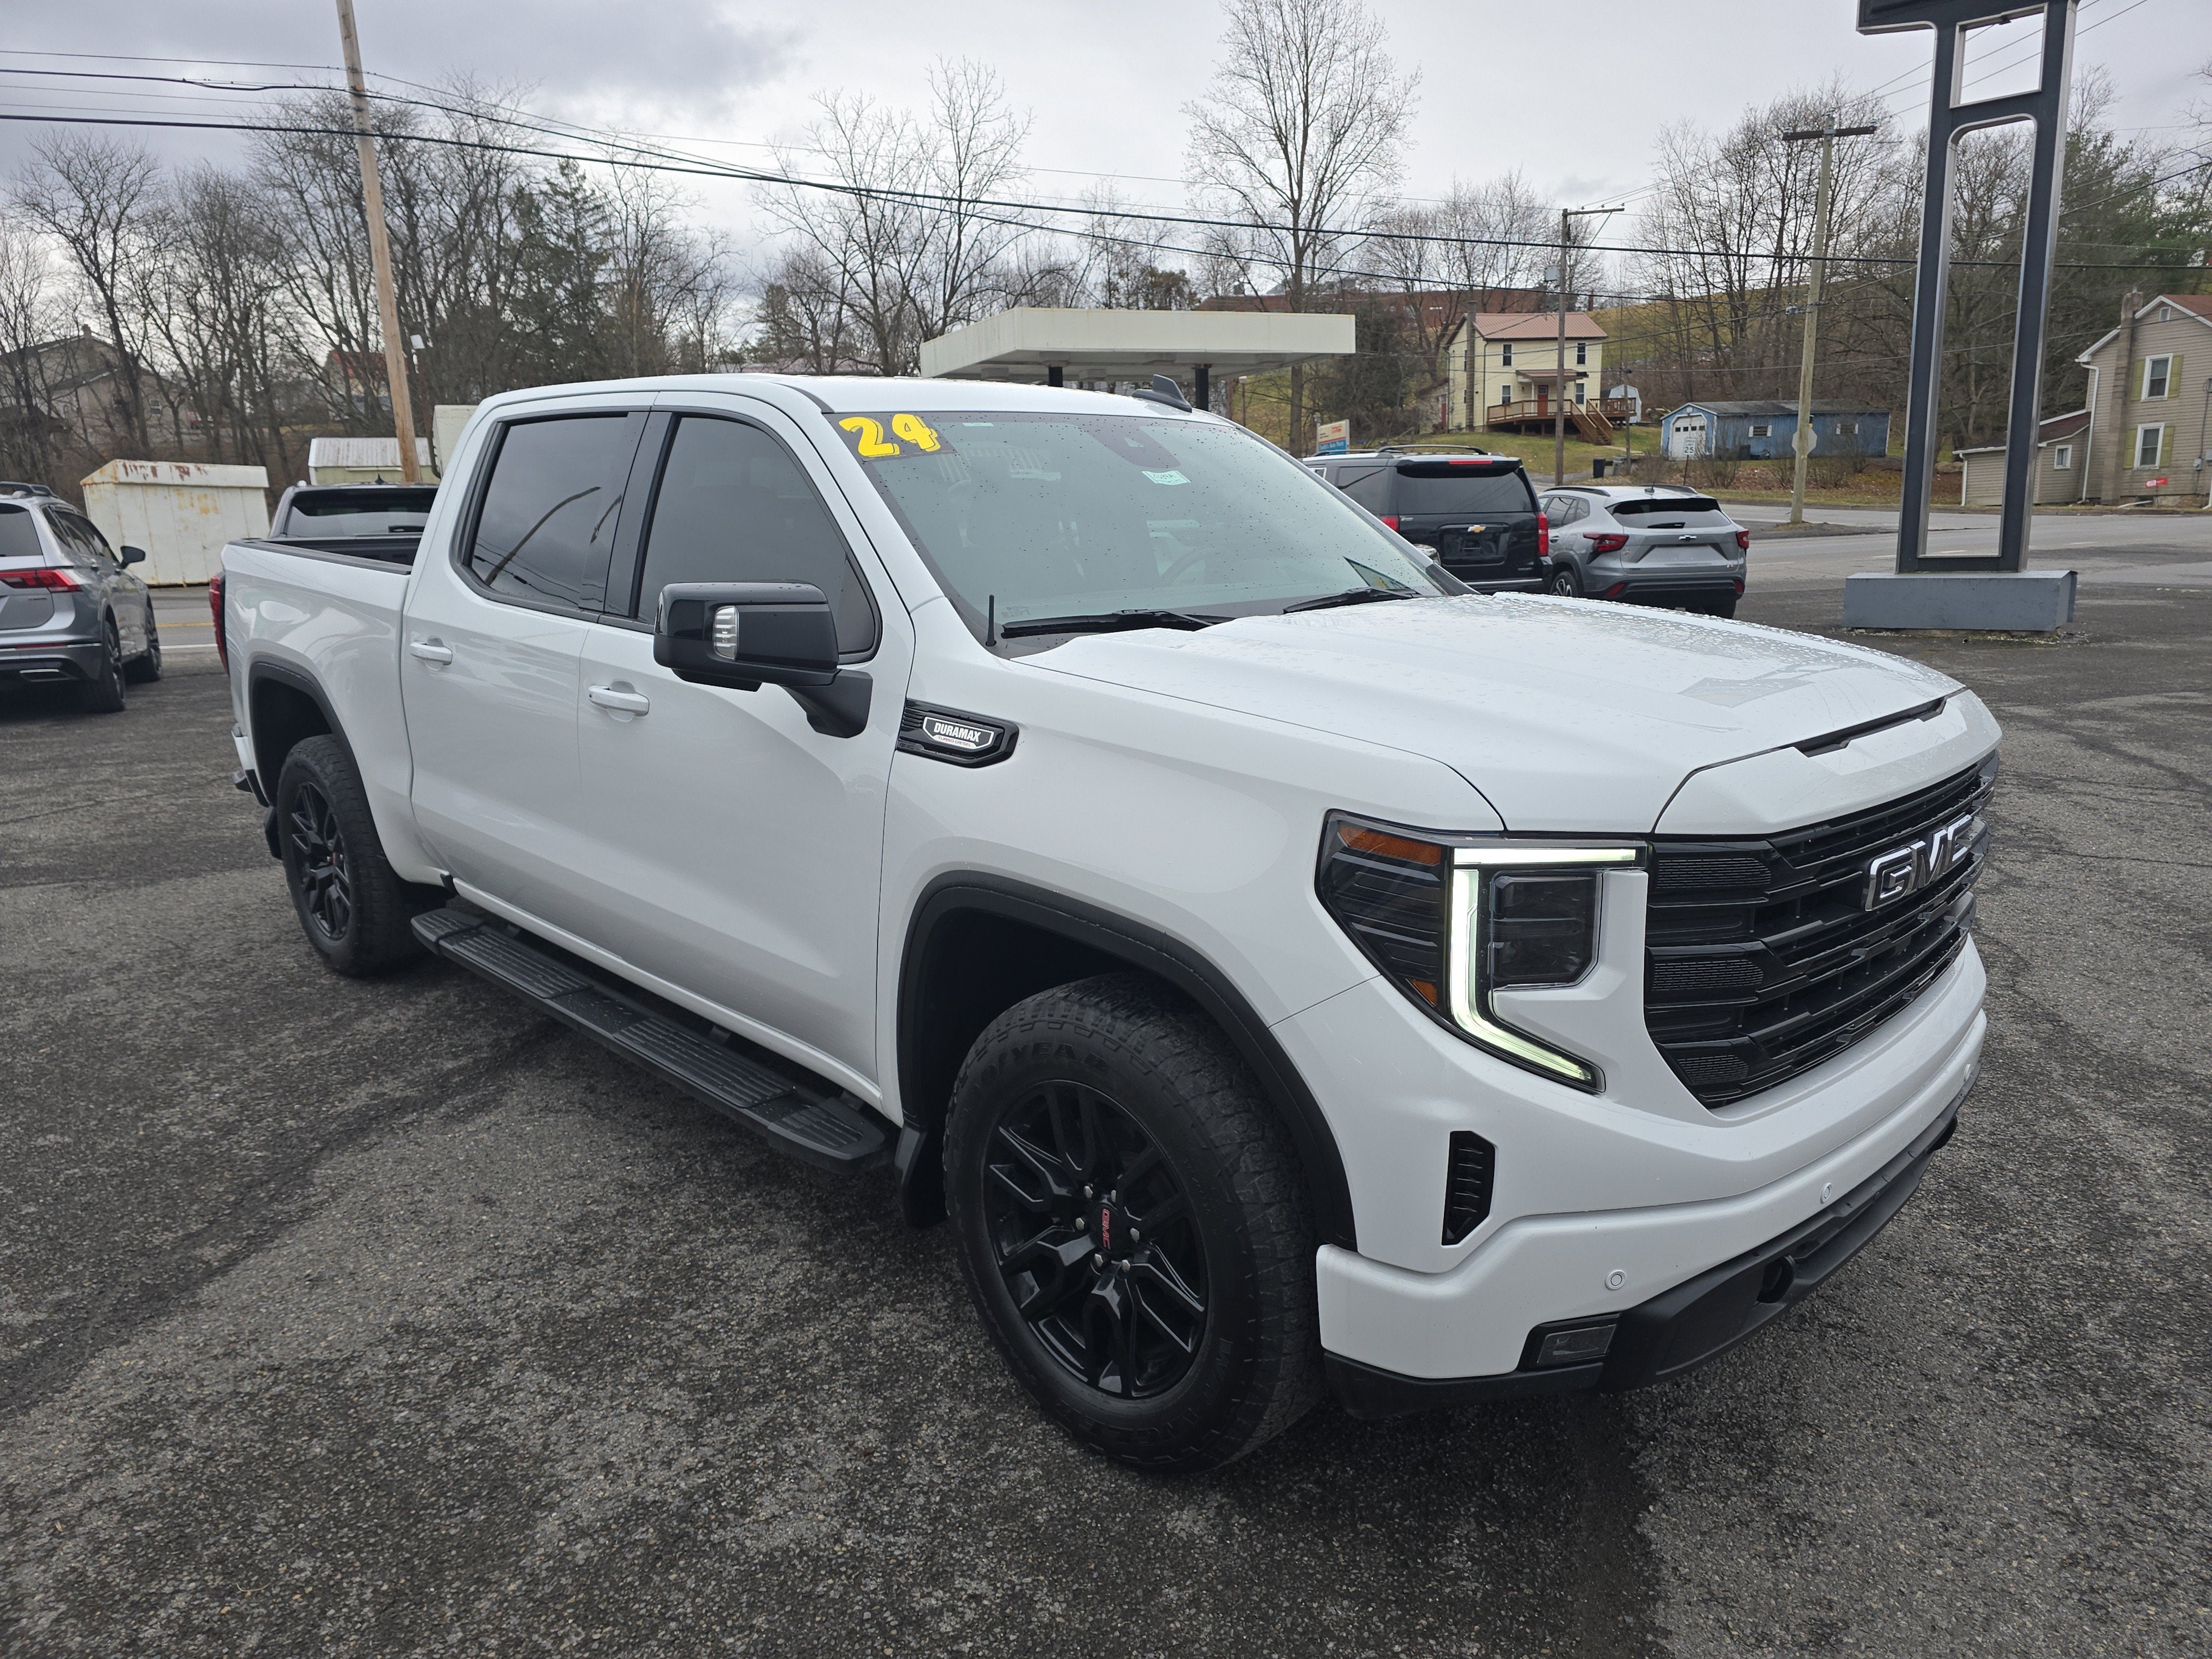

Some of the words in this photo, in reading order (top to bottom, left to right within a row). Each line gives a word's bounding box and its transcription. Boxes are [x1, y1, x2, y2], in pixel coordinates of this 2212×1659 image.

[839, 413, 941, 456] 24
[934, 722, 981, 743] DURAMAX
[1865, 813, 1973, 912] GMC
[1102, 1208, 1111, 1250] GMC
